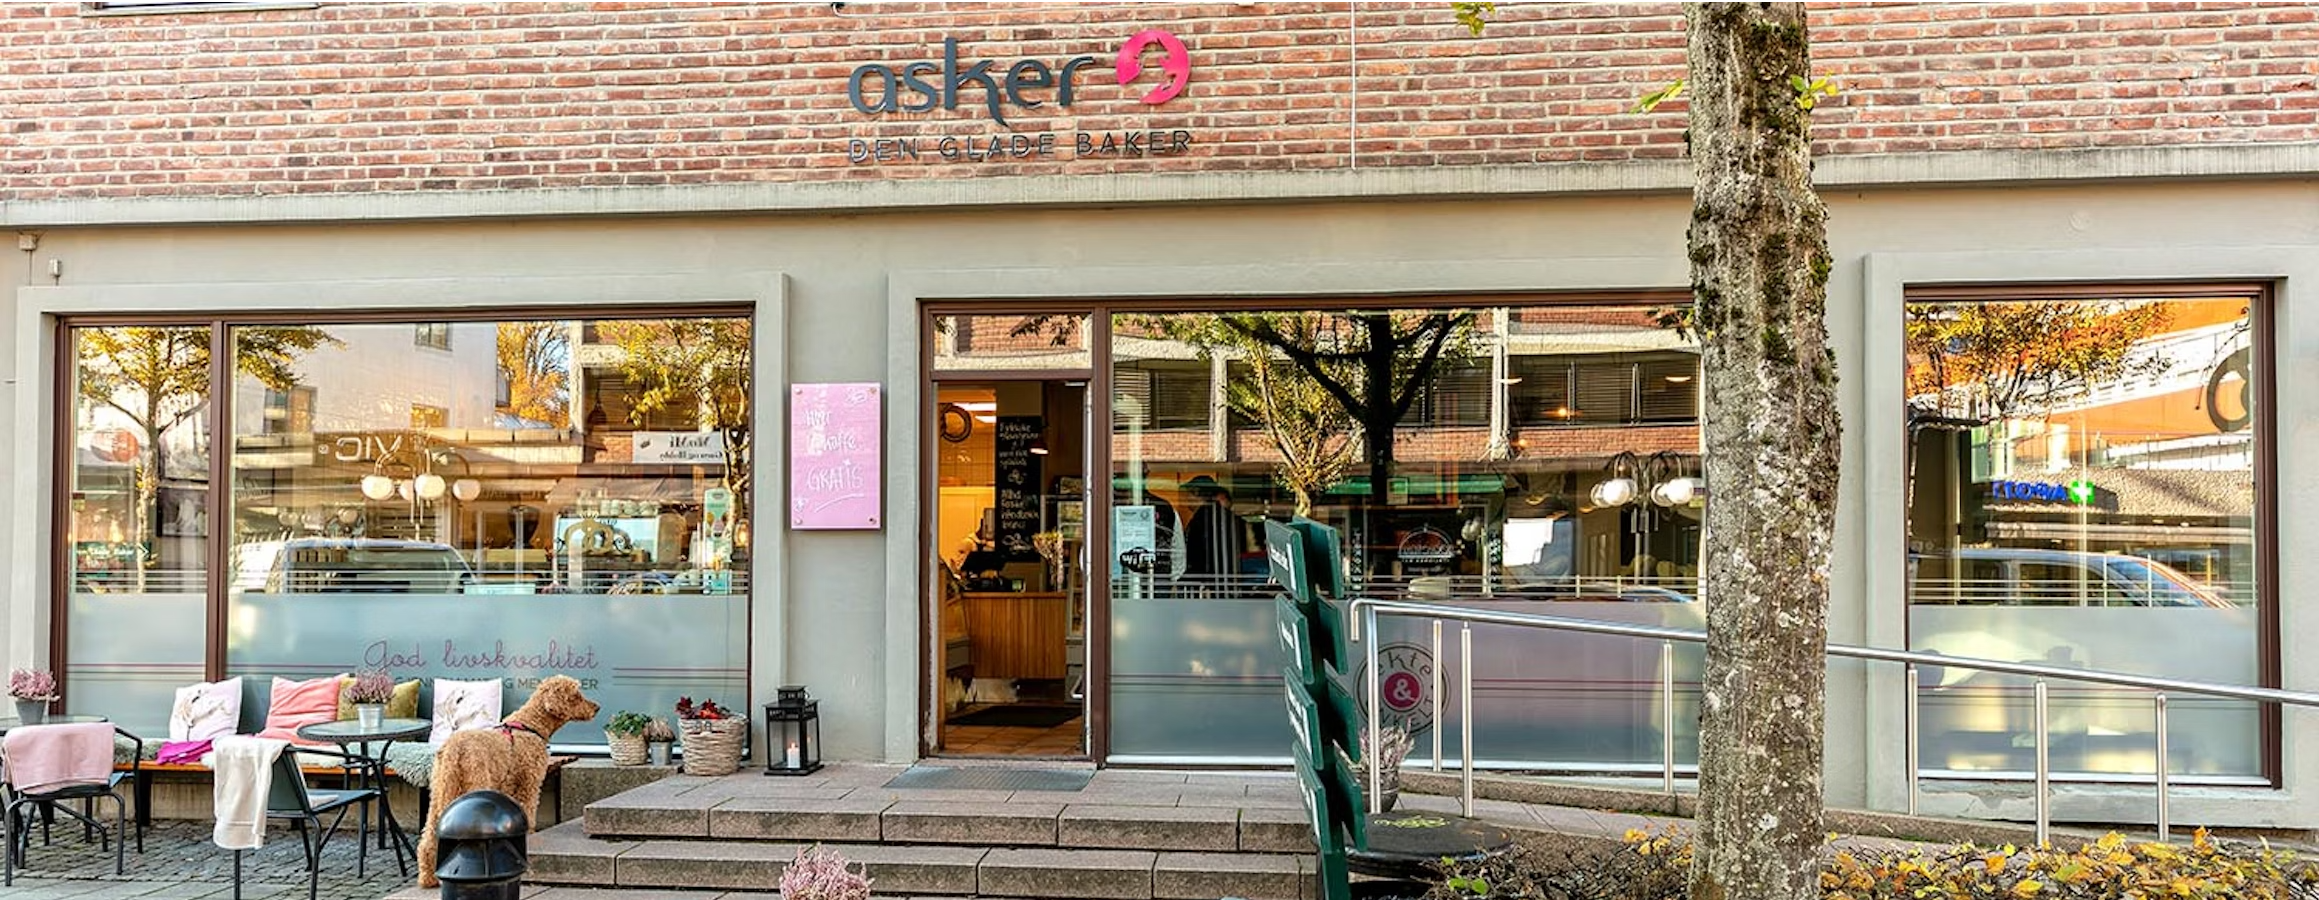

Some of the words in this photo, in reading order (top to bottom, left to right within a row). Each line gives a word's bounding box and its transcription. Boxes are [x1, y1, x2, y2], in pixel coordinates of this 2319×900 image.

[848, 37, 1094, 128] asker
[848, 138, 918, 163] DEN
[939, 133, 1055, 159] GLADE
[1076, 130, 1192, 155] BAKER
[363, 640, 427, 670] God
[442, 638, 598, 670] livskvalitet
